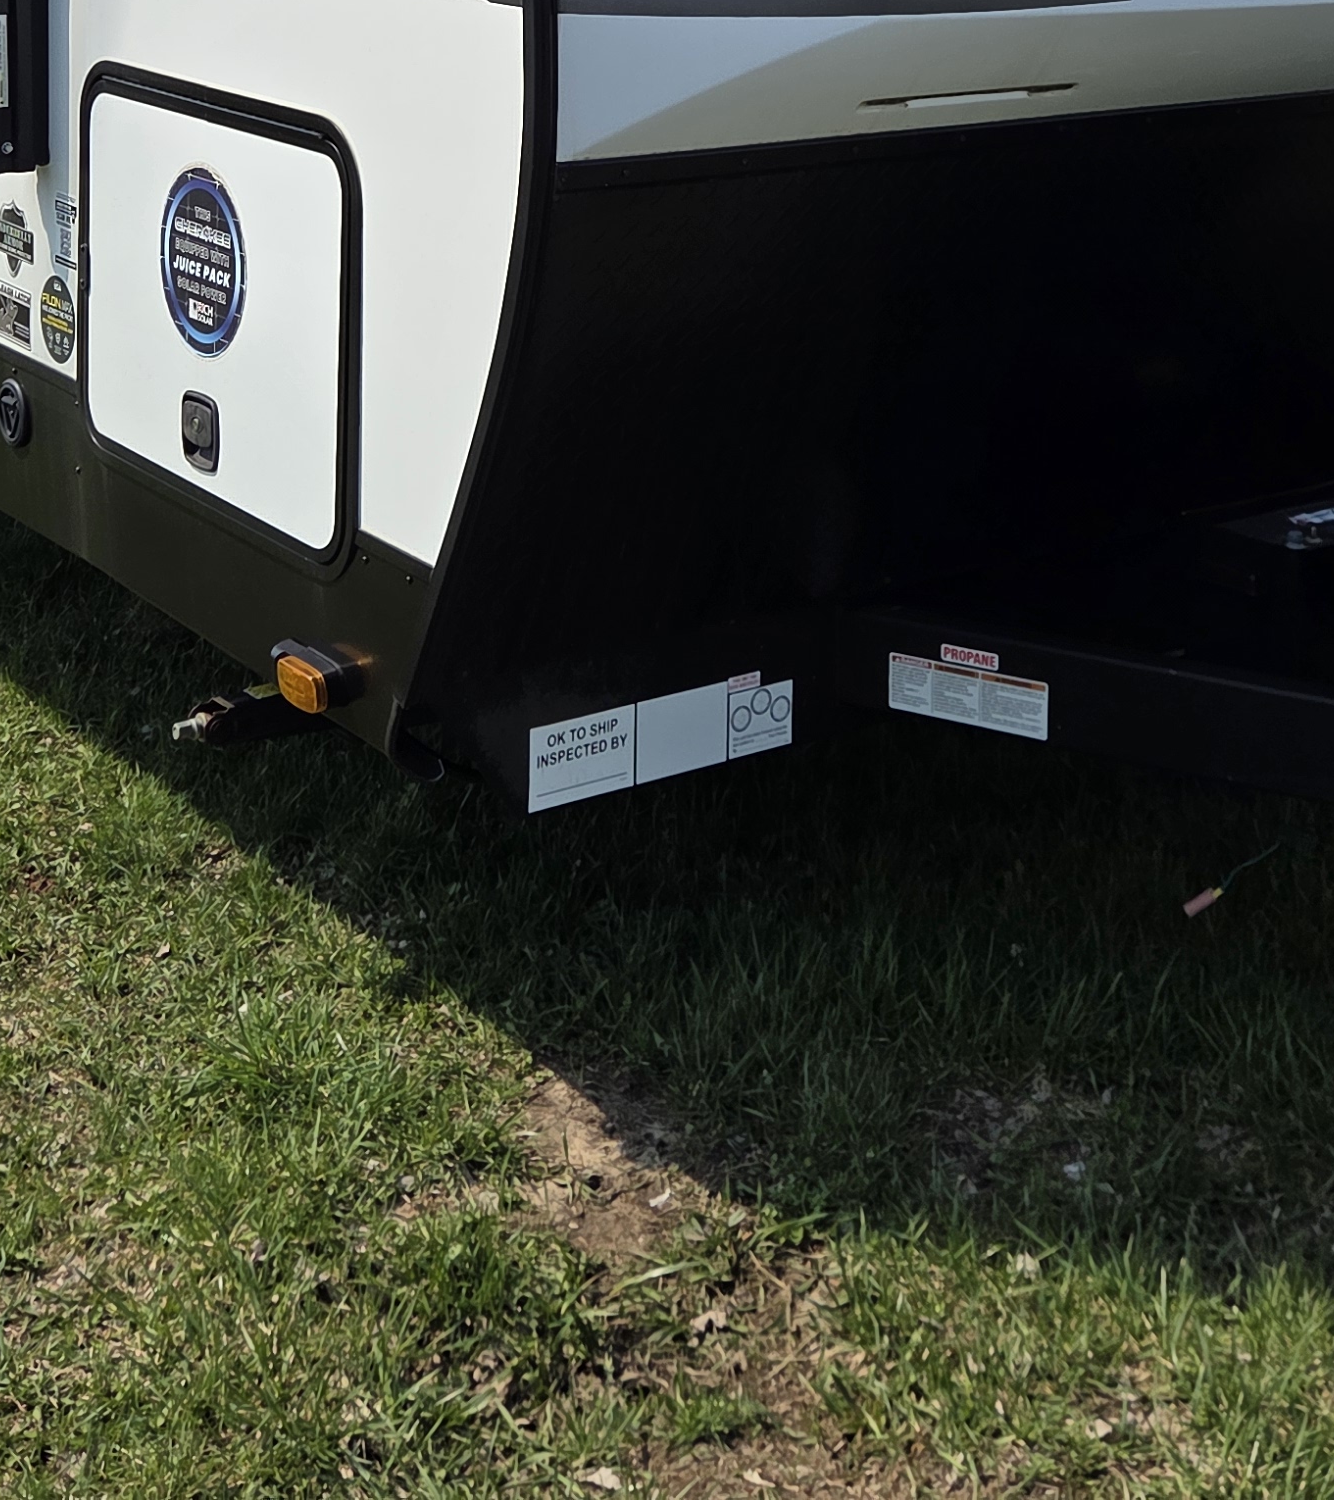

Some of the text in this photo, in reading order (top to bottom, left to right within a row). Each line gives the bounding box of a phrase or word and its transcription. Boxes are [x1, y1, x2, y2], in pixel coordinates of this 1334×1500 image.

[194, 206, 210, 221] THIS
[175, 217, 231, 249] CHEROKEE
[175, 237, 229, 268] EQUIPPED WITH
[173, 255, 231, 287] JUICE PACK
[177, 276, 226, 304] SOLAR POWER
[942, 646, 996, 668] PROPANE
[547, 718, 619, 748] OK TO SHIP
[536, 733, 628, 769] INSPECTED BY
